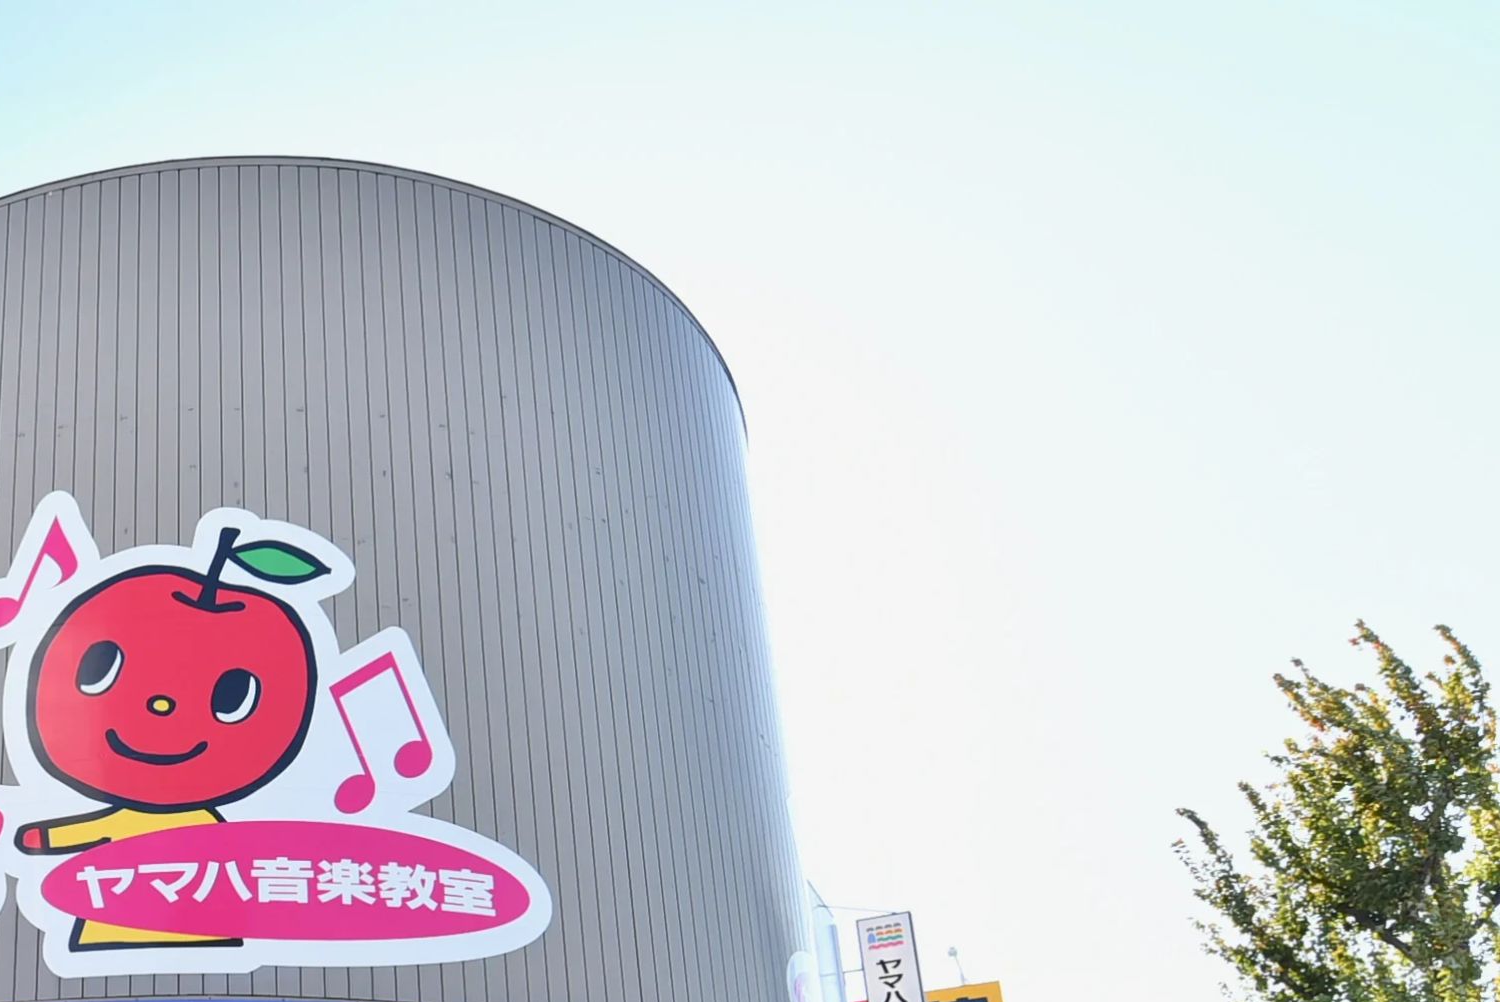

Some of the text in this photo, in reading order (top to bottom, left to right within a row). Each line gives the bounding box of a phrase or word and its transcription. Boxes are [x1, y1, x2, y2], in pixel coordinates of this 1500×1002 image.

[77, 857, 497, 917] ヤマハ音楽教室
